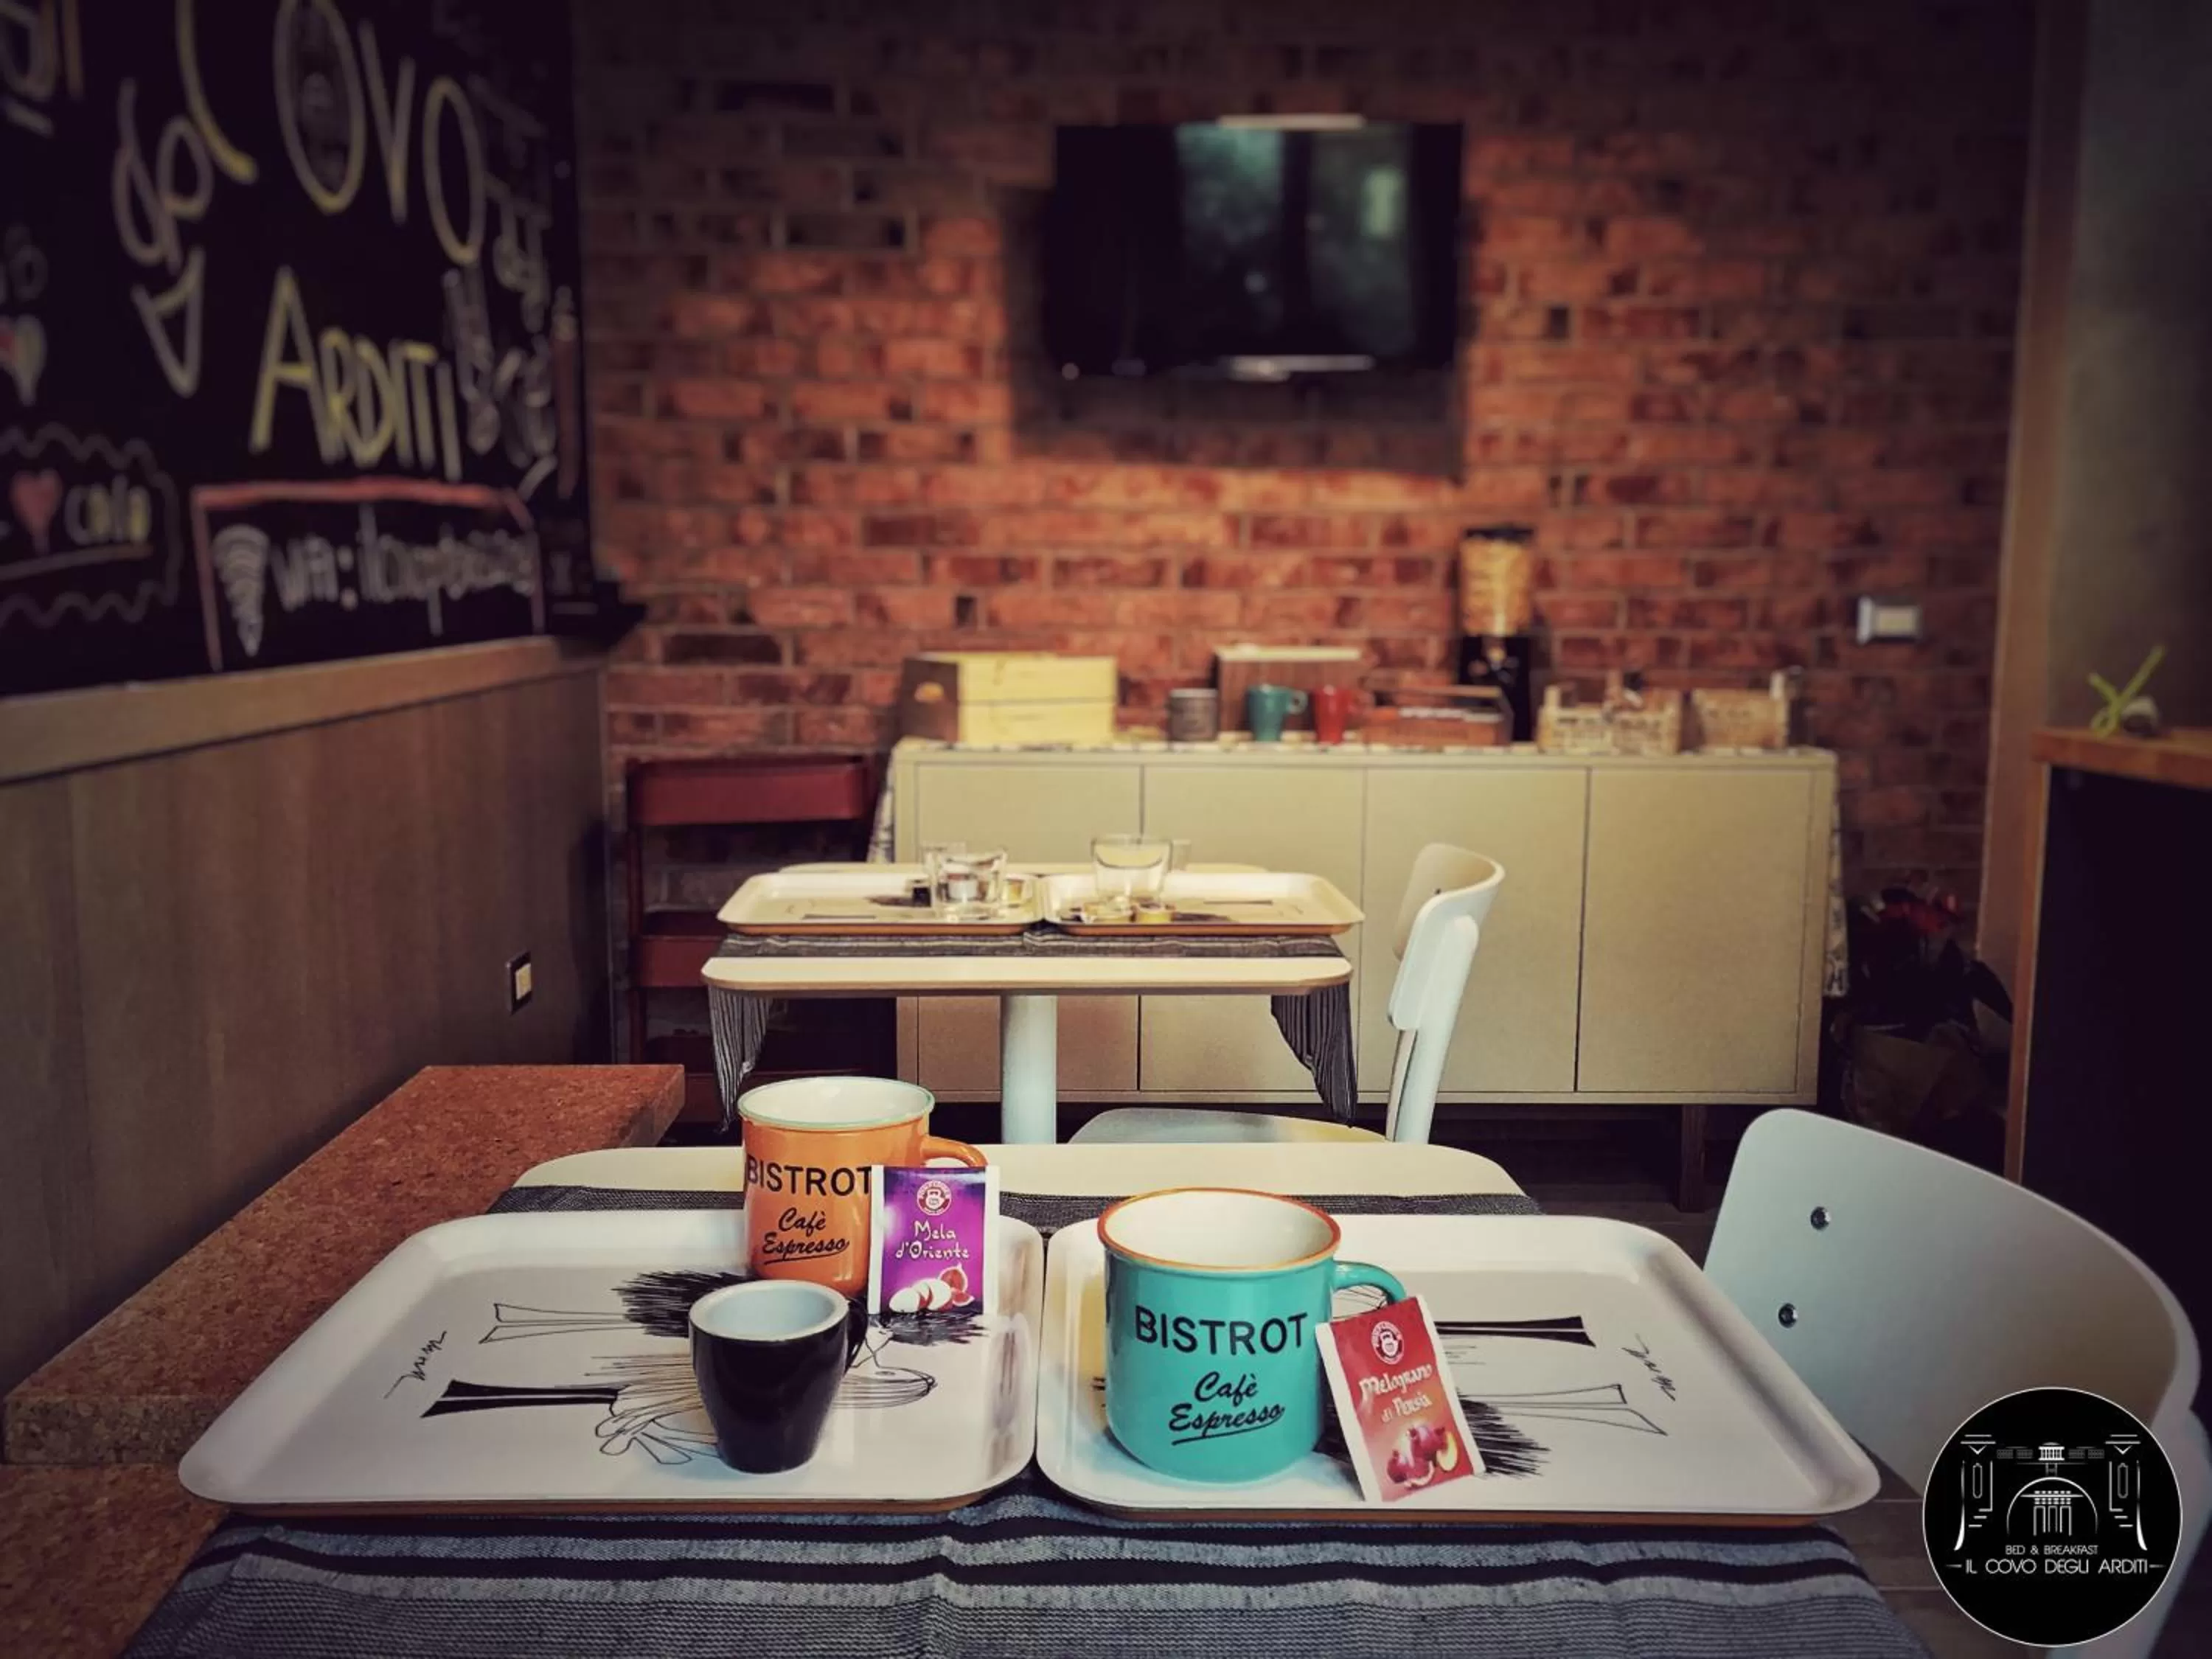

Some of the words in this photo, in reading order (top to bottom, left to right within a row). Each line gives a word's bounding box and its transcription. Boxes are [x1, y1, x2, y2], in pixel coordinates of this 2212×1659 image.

[745, 1154, 872, 1196] BISTROT
[778, 1207, 827, 1236] Cafè
[914, 1220, 956, 1240] Mela
[762, 1233, 850, 1260] Espresso
[895, 1240, 970, 1259] d'Oriente
[1135, 1305, 1308, 1355] BISTROT
[1194, 1371, 1259, 1406] Cafè
[1169, 1403, 1285, 1439] Espresso
